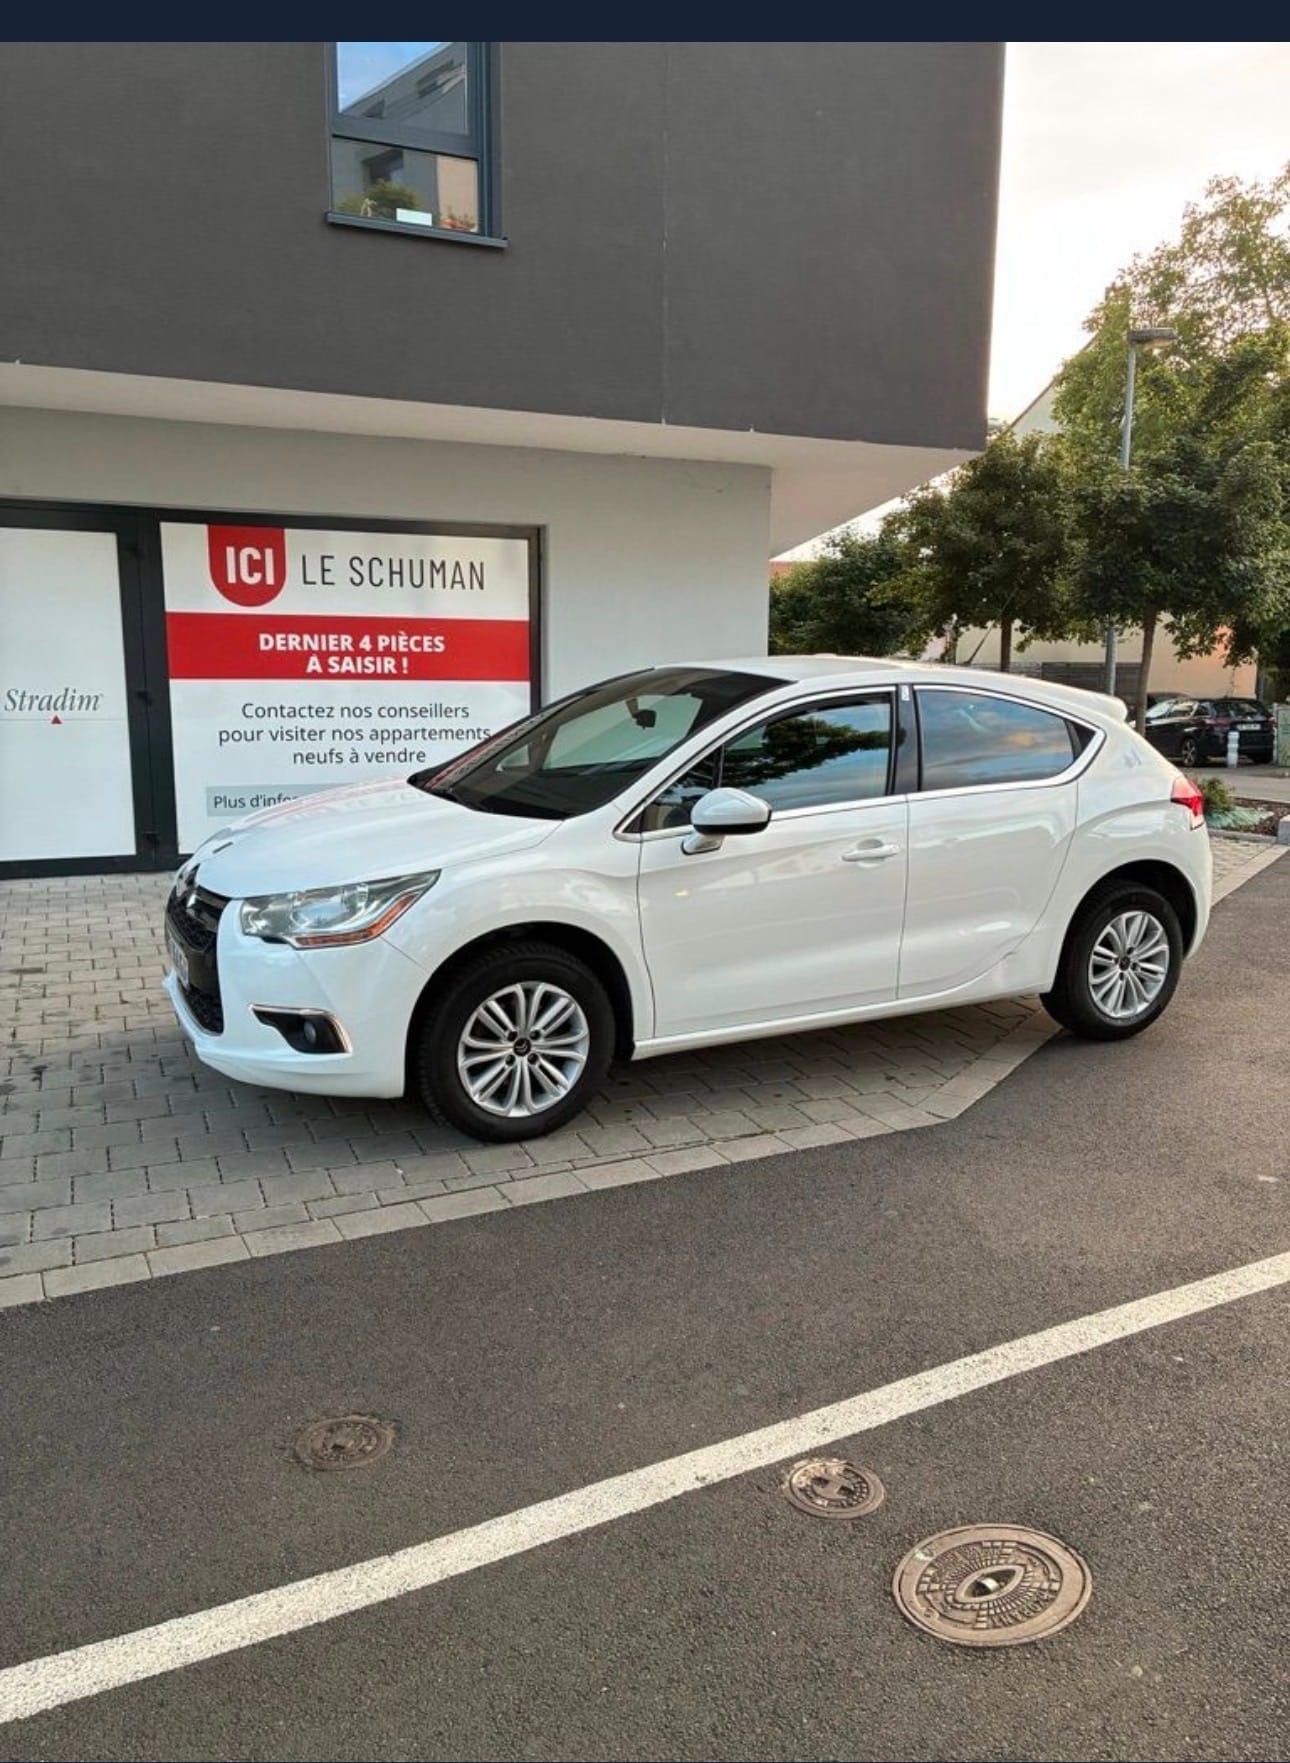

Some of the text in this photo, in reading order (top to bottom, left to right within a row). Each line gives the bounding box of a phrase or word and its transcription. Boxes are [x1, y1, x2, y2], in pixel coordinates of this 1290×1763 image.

[226, 546, 485, 590] ICI LE SCHUMAN
[259, 631, 445, 652] DERNIER 4 PIÈCES
[328, 656, 397, 674] SAISIR
[402, 657, 409, 674] !
[4, 687, 100, 712] Stradim
[241, 703, 470, 719] Contactez nos conseillers
[218, 726, 491, 747] pour visiter nos appartements
[293, 747, 426, 764] neufs à vendre
[213, 793, 299, 809] Plus d'inf
